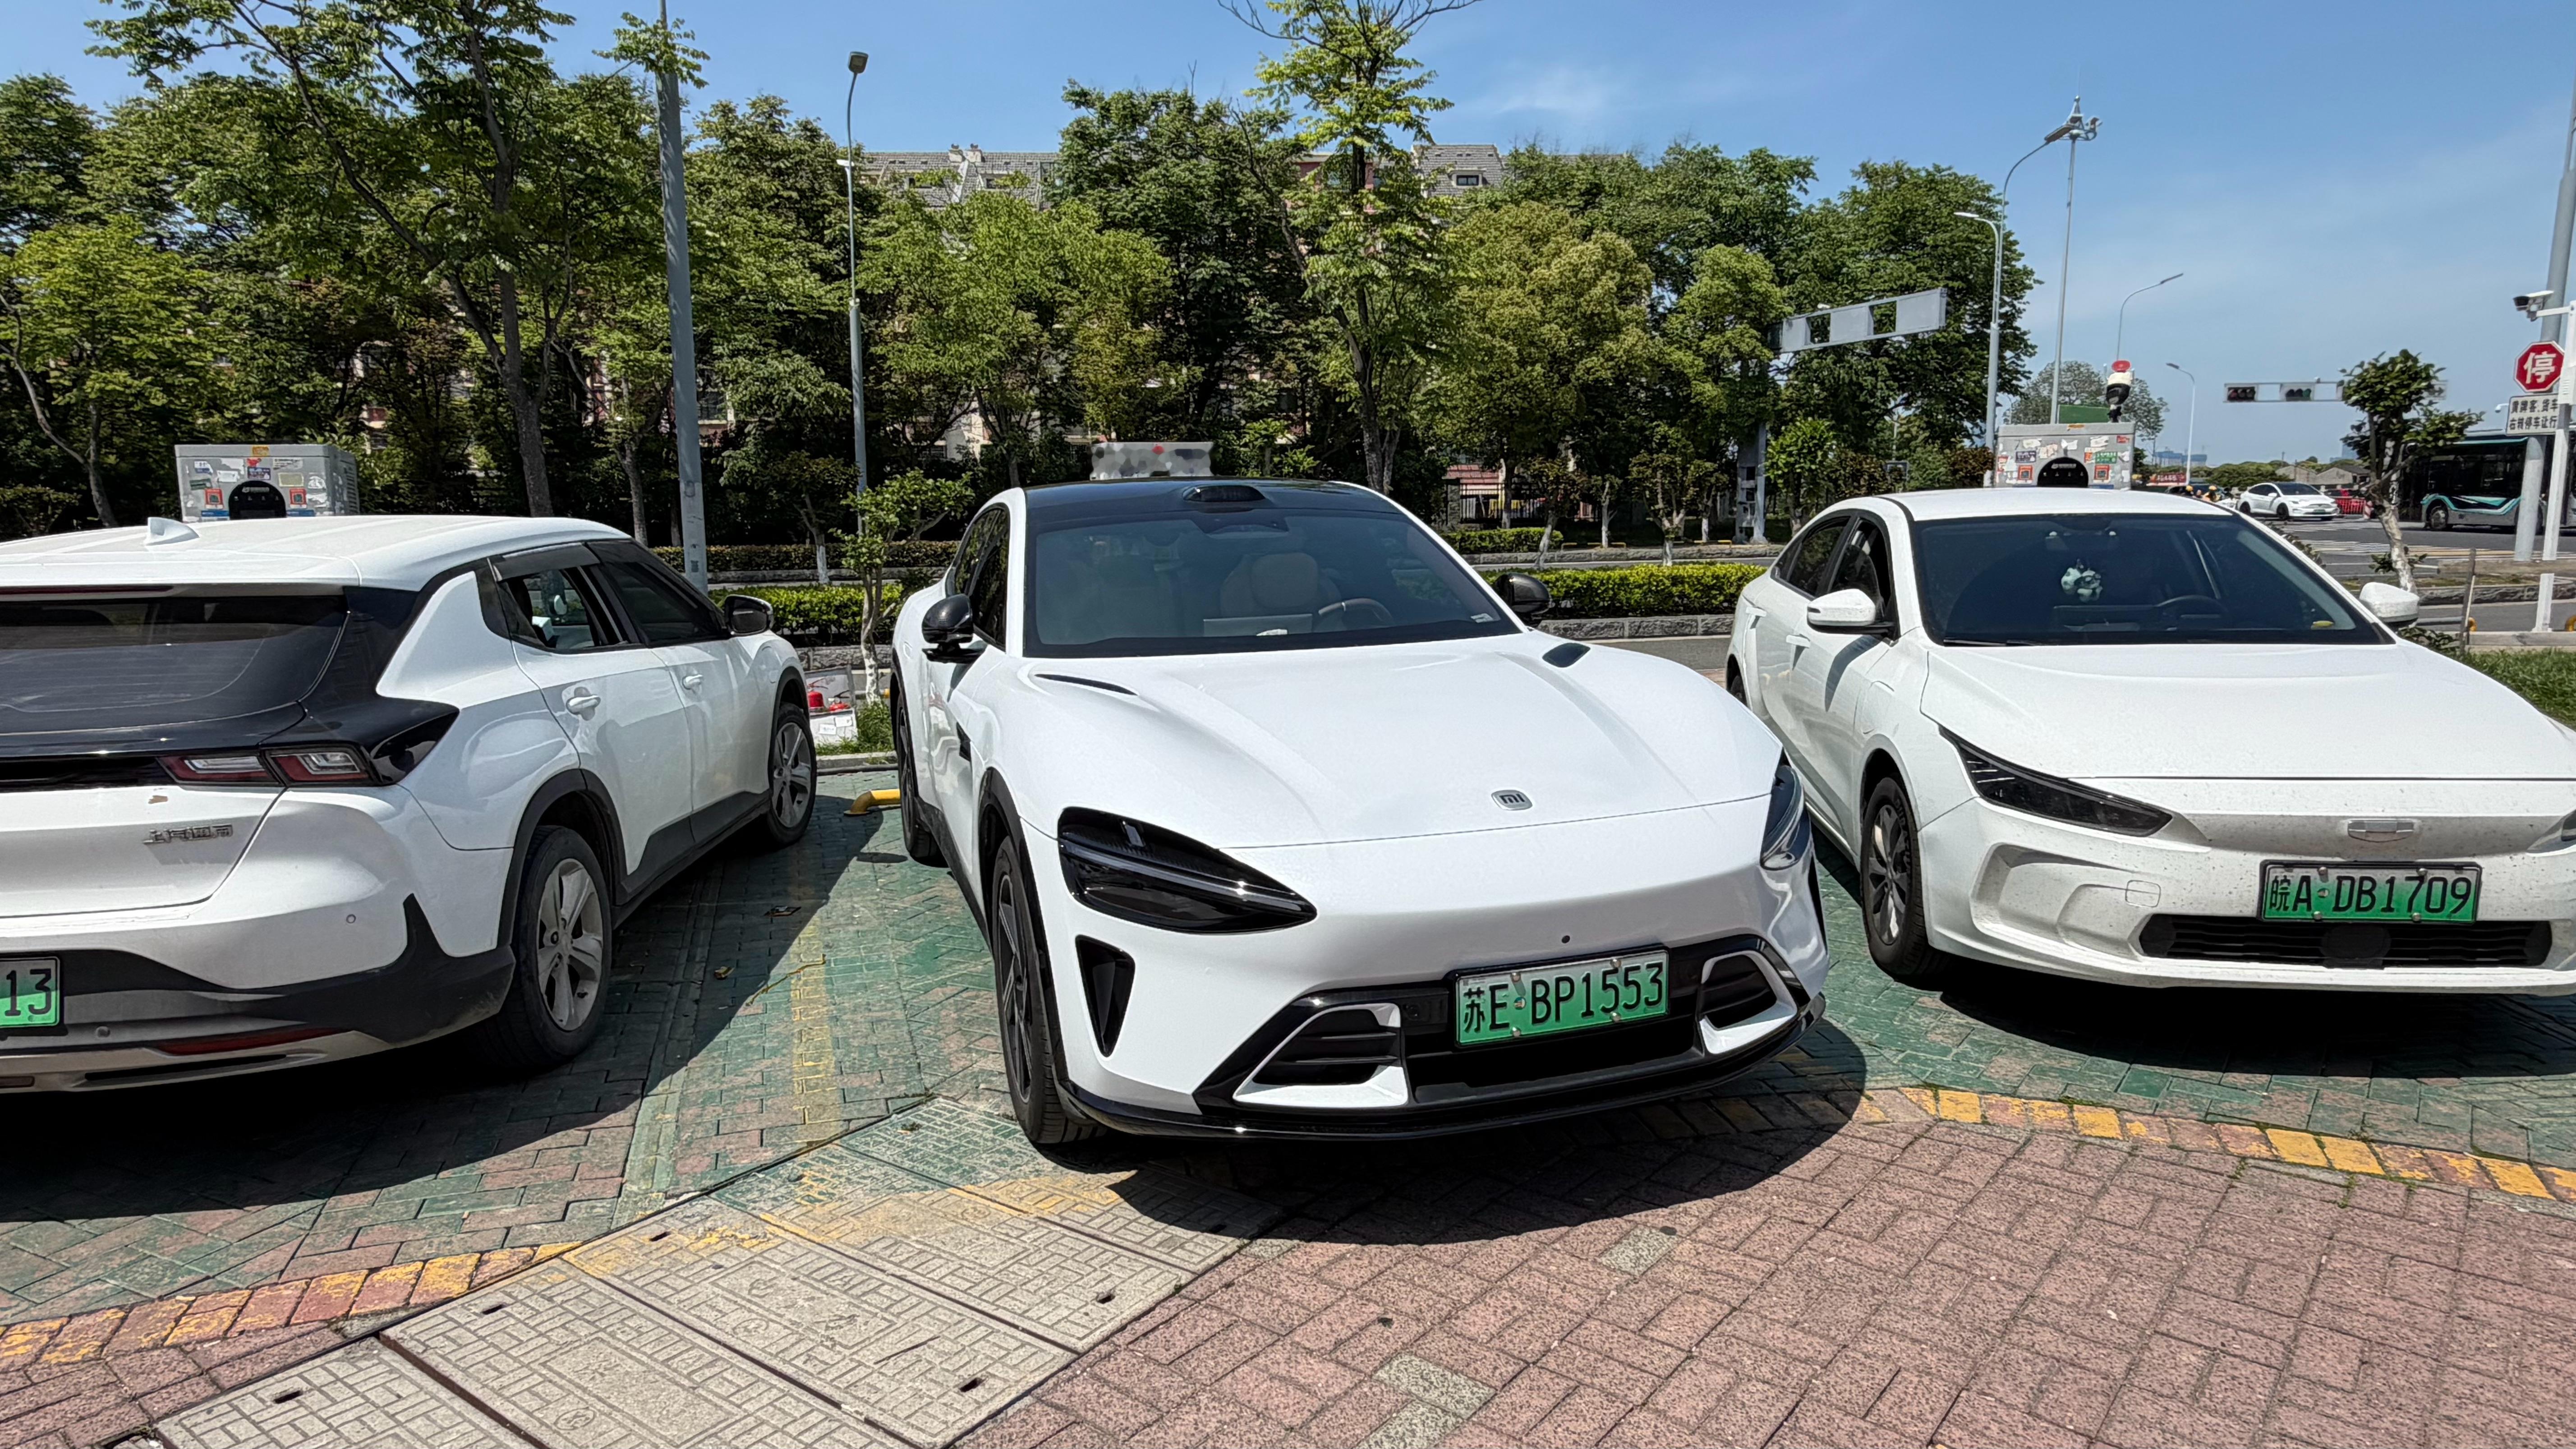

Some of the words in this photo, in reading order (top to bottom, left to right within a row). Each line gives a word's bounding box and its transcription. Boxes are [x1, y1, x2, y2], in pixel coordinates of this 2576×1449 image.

[2523, 351, 2556, 384] 停
[2509, 416, 2558, 430] 右转停车让行
[5, 969, 51, 1016] 13
